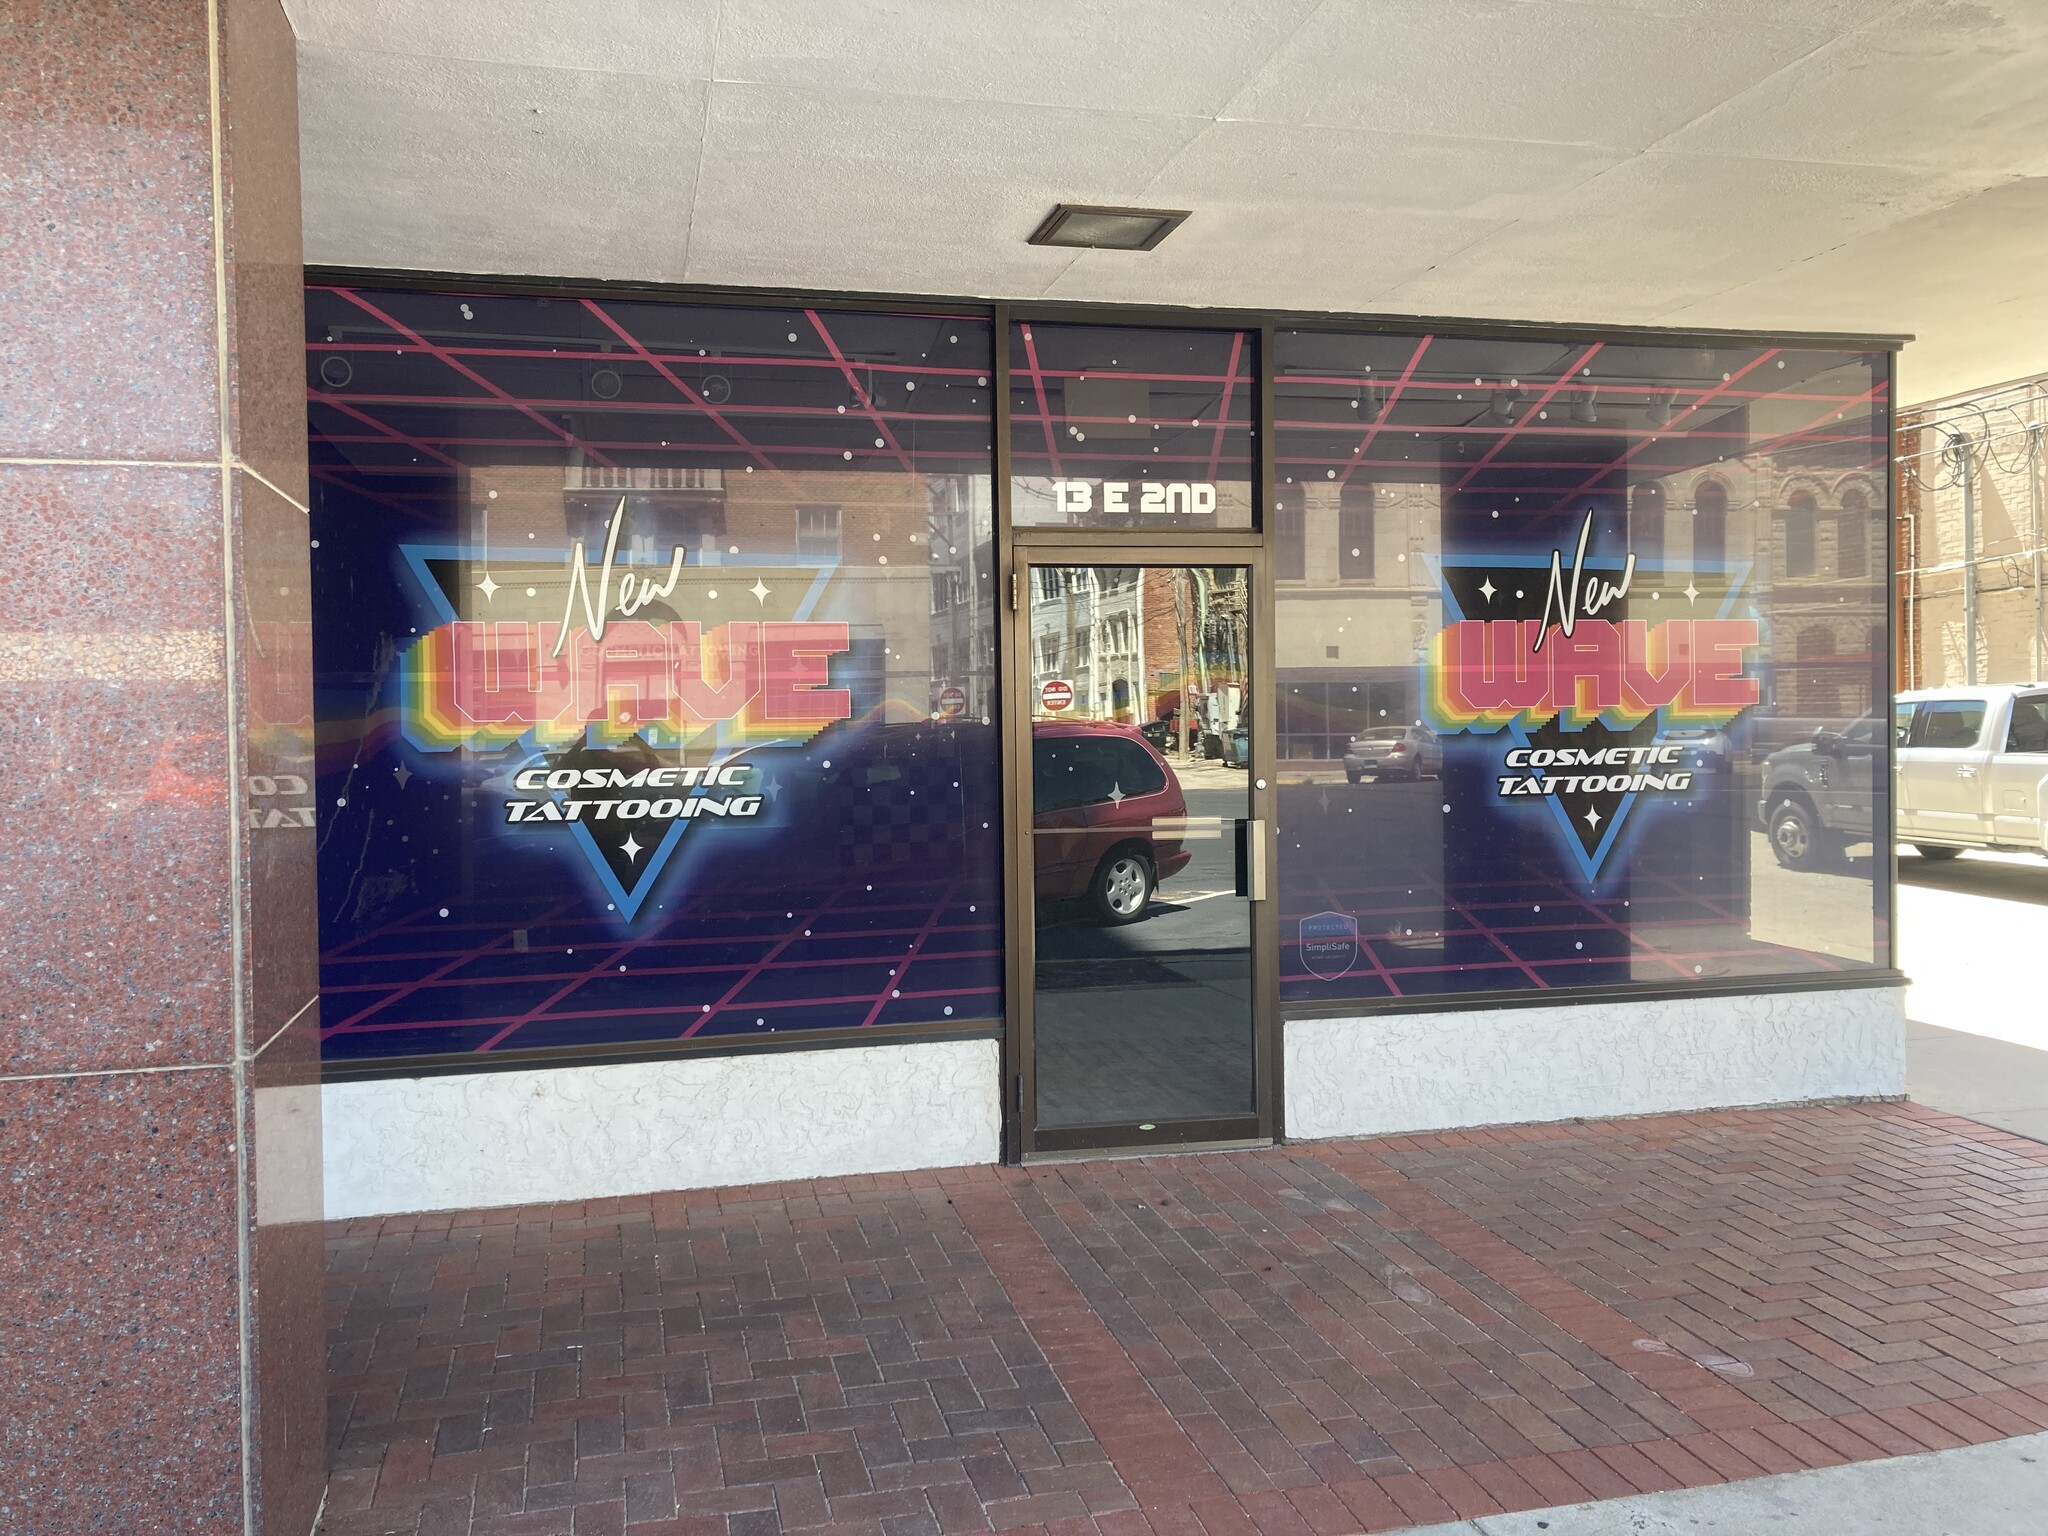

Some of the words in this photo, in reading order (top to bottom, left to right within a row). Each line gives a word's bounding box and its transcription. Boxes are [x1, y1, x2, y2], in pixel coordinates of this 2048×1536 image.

[1052, 482, 1092, 512] 13
[1104, 483, 1129, 512] E
[1141, 483, 1216, 513] 2ND
[552, 495, 685, 658] New
[1534, 508, 1635, 652] New
[450, 620, 851, 724] WAVE
[1458, 620, 1760, 709] WAVE
[1505, 746, 1684, 767] COSMETIC
[515, 766, 750, 790] COSMETIC
[1499, 773, 1692, 795] TATTOOING
[507, 797, 761, 822] TATTOOING
[1305, 942, 1350, 952] SimpliSafe
